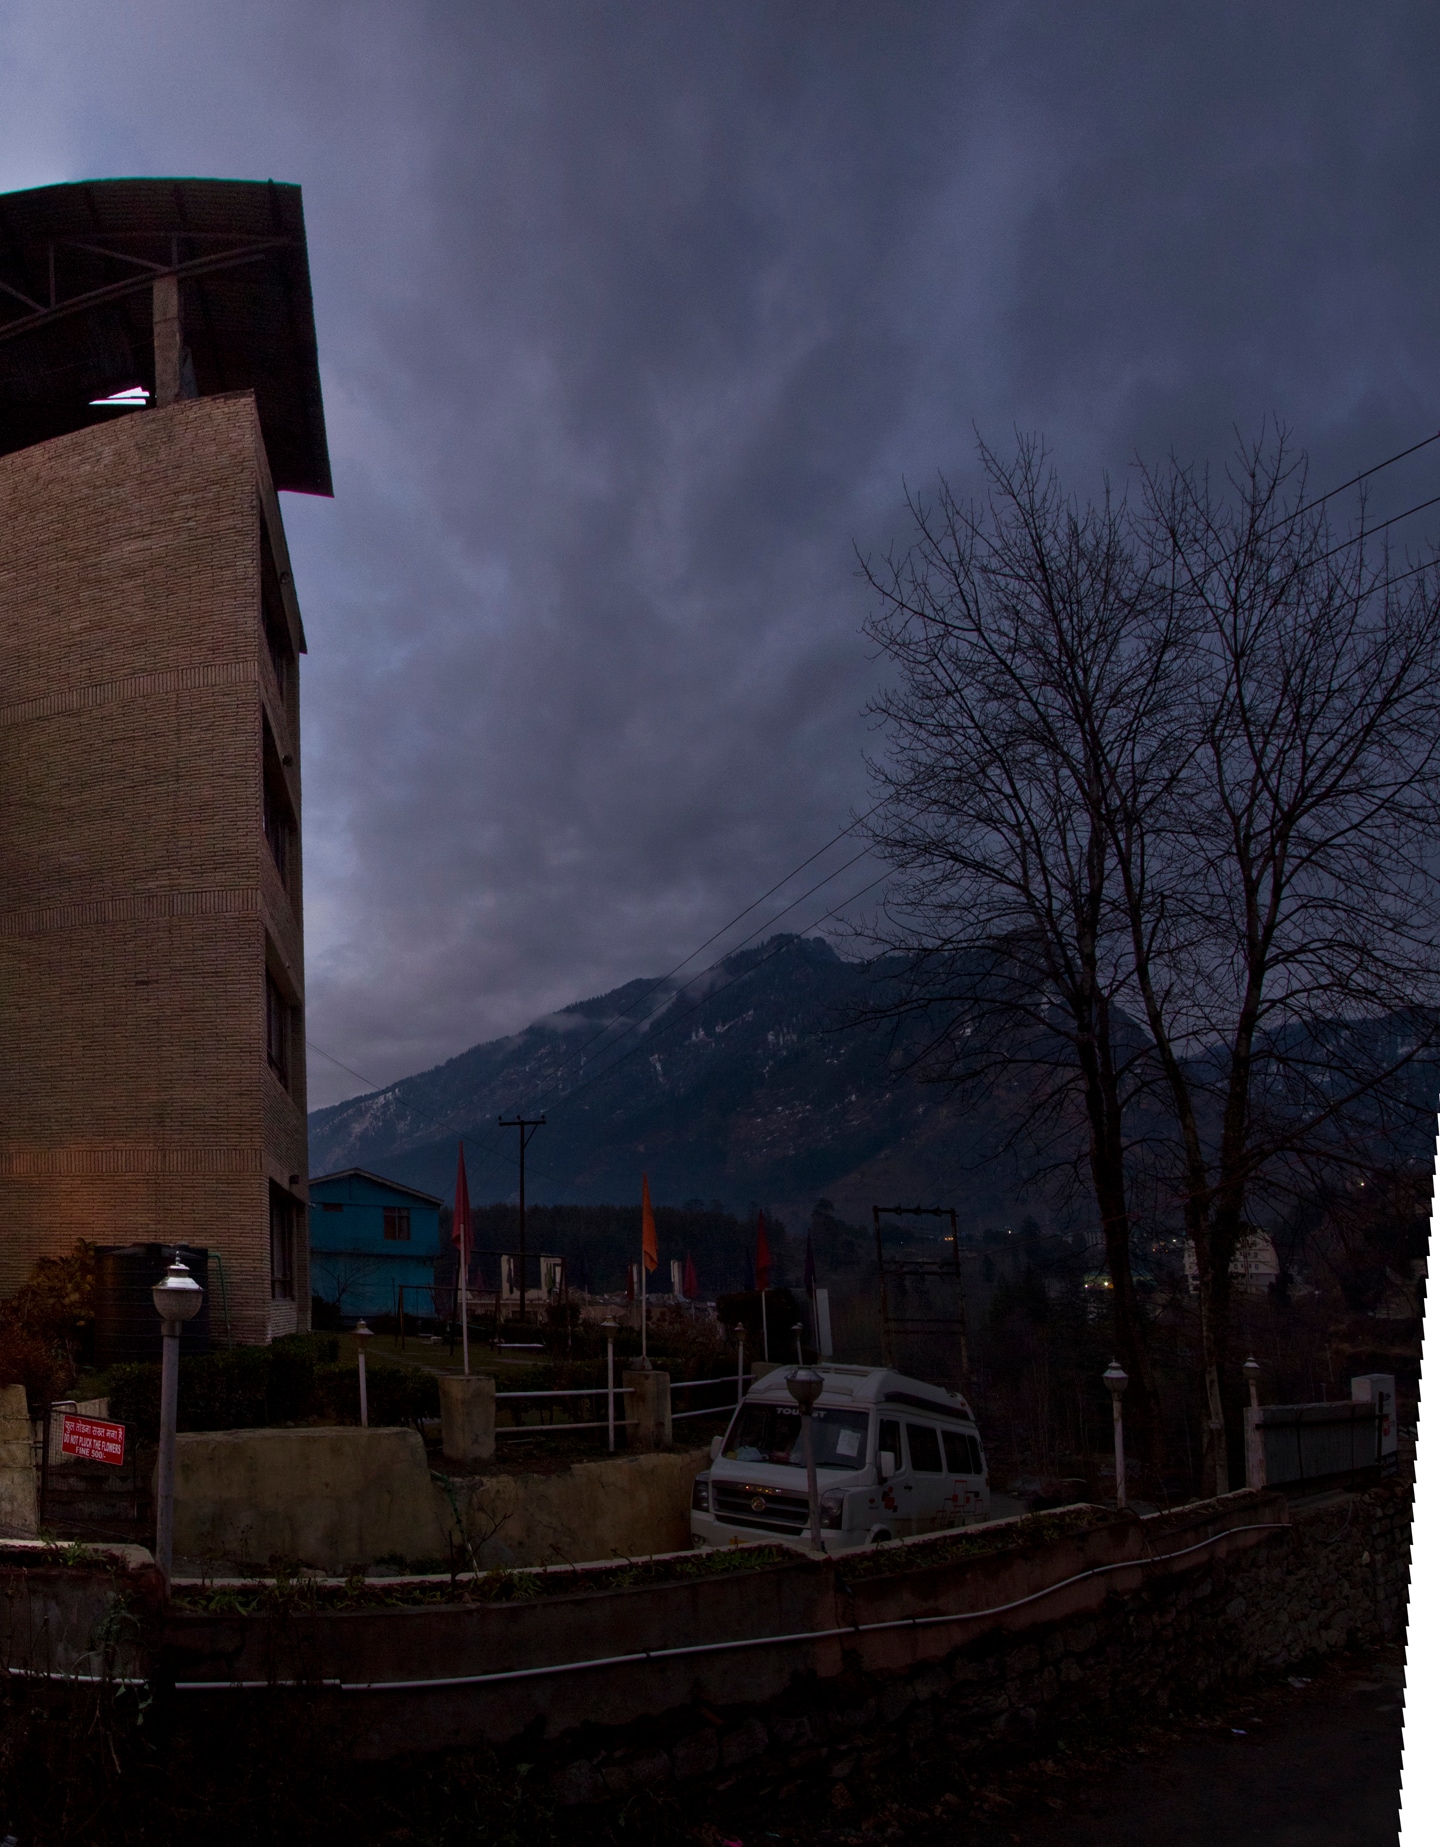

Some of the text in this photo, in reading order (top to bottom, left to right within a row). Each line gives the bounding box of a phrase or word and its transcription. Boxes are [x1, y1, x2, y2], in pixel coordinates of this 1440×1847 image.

[776, 1407, 827, 1418] TOUST
[63, 1433, 121, 1454] DO NOT PLUCK THE FLOWERS
[75, 1446, 106, 1459] FINE 500/-
